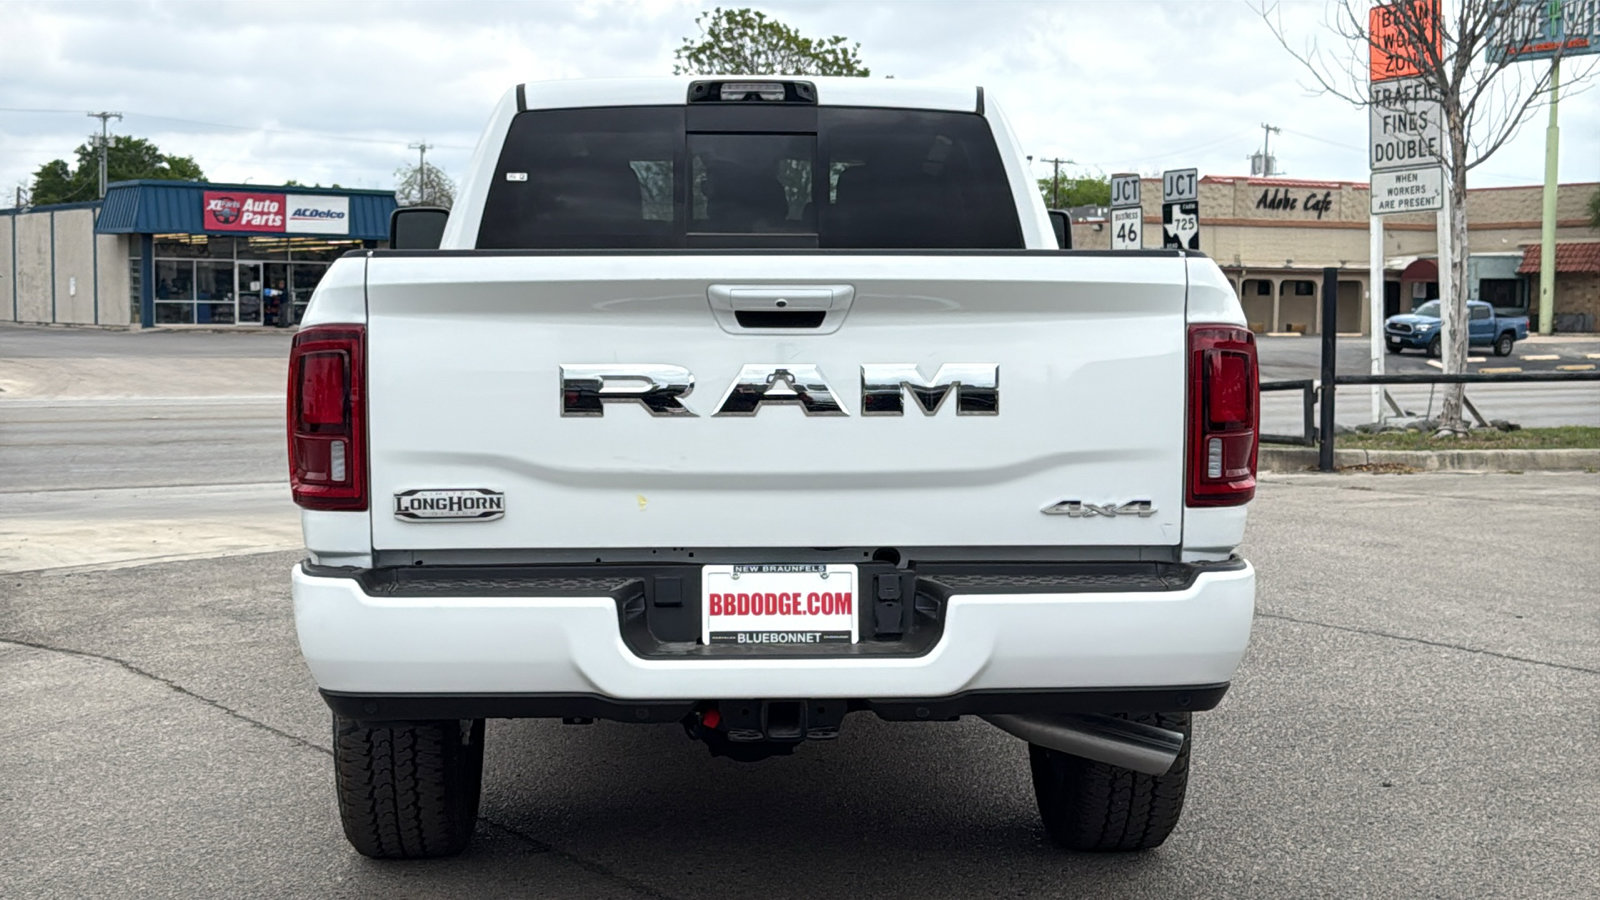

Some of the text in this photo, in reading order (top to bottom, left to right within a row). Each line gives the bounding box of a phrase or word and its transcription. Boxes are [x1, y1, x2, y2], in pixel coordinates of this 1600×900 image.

[1385, 50, 1427, 73] ZON
[1374, 83, 1438, 108] TRAFFIC
[1383, 111, 1428, 134] FINES
[1375, 137, 1437, 162] DOUBLE
[1165, 174, 1195, 197] JCT
[1395, 173, 1418, 183] WHEN
[1113, 180, 1138, 202] JCT
[1387, 185, 1426, 197] WORKERS
[242, 198, 279, 213] Auto
[1256, 188, 1332, 220] Adobe Cafe
[1379, 196, 1436, 210] ARE PRESENT
[241, 211, 282, 227] Parts
[291, 208, 345, 219] ACDelco
[1116, 223, 1138, 243] 46
[1174, 218, 1195, 231] 725
[560, 363, 1000, 417] RAM
[735, 564, 825, 573] NEW BRAUNFELS
[709, 592, 852, 616] BBDODGE.COM
[737, 632, 822, 643] BLUEBONNET
